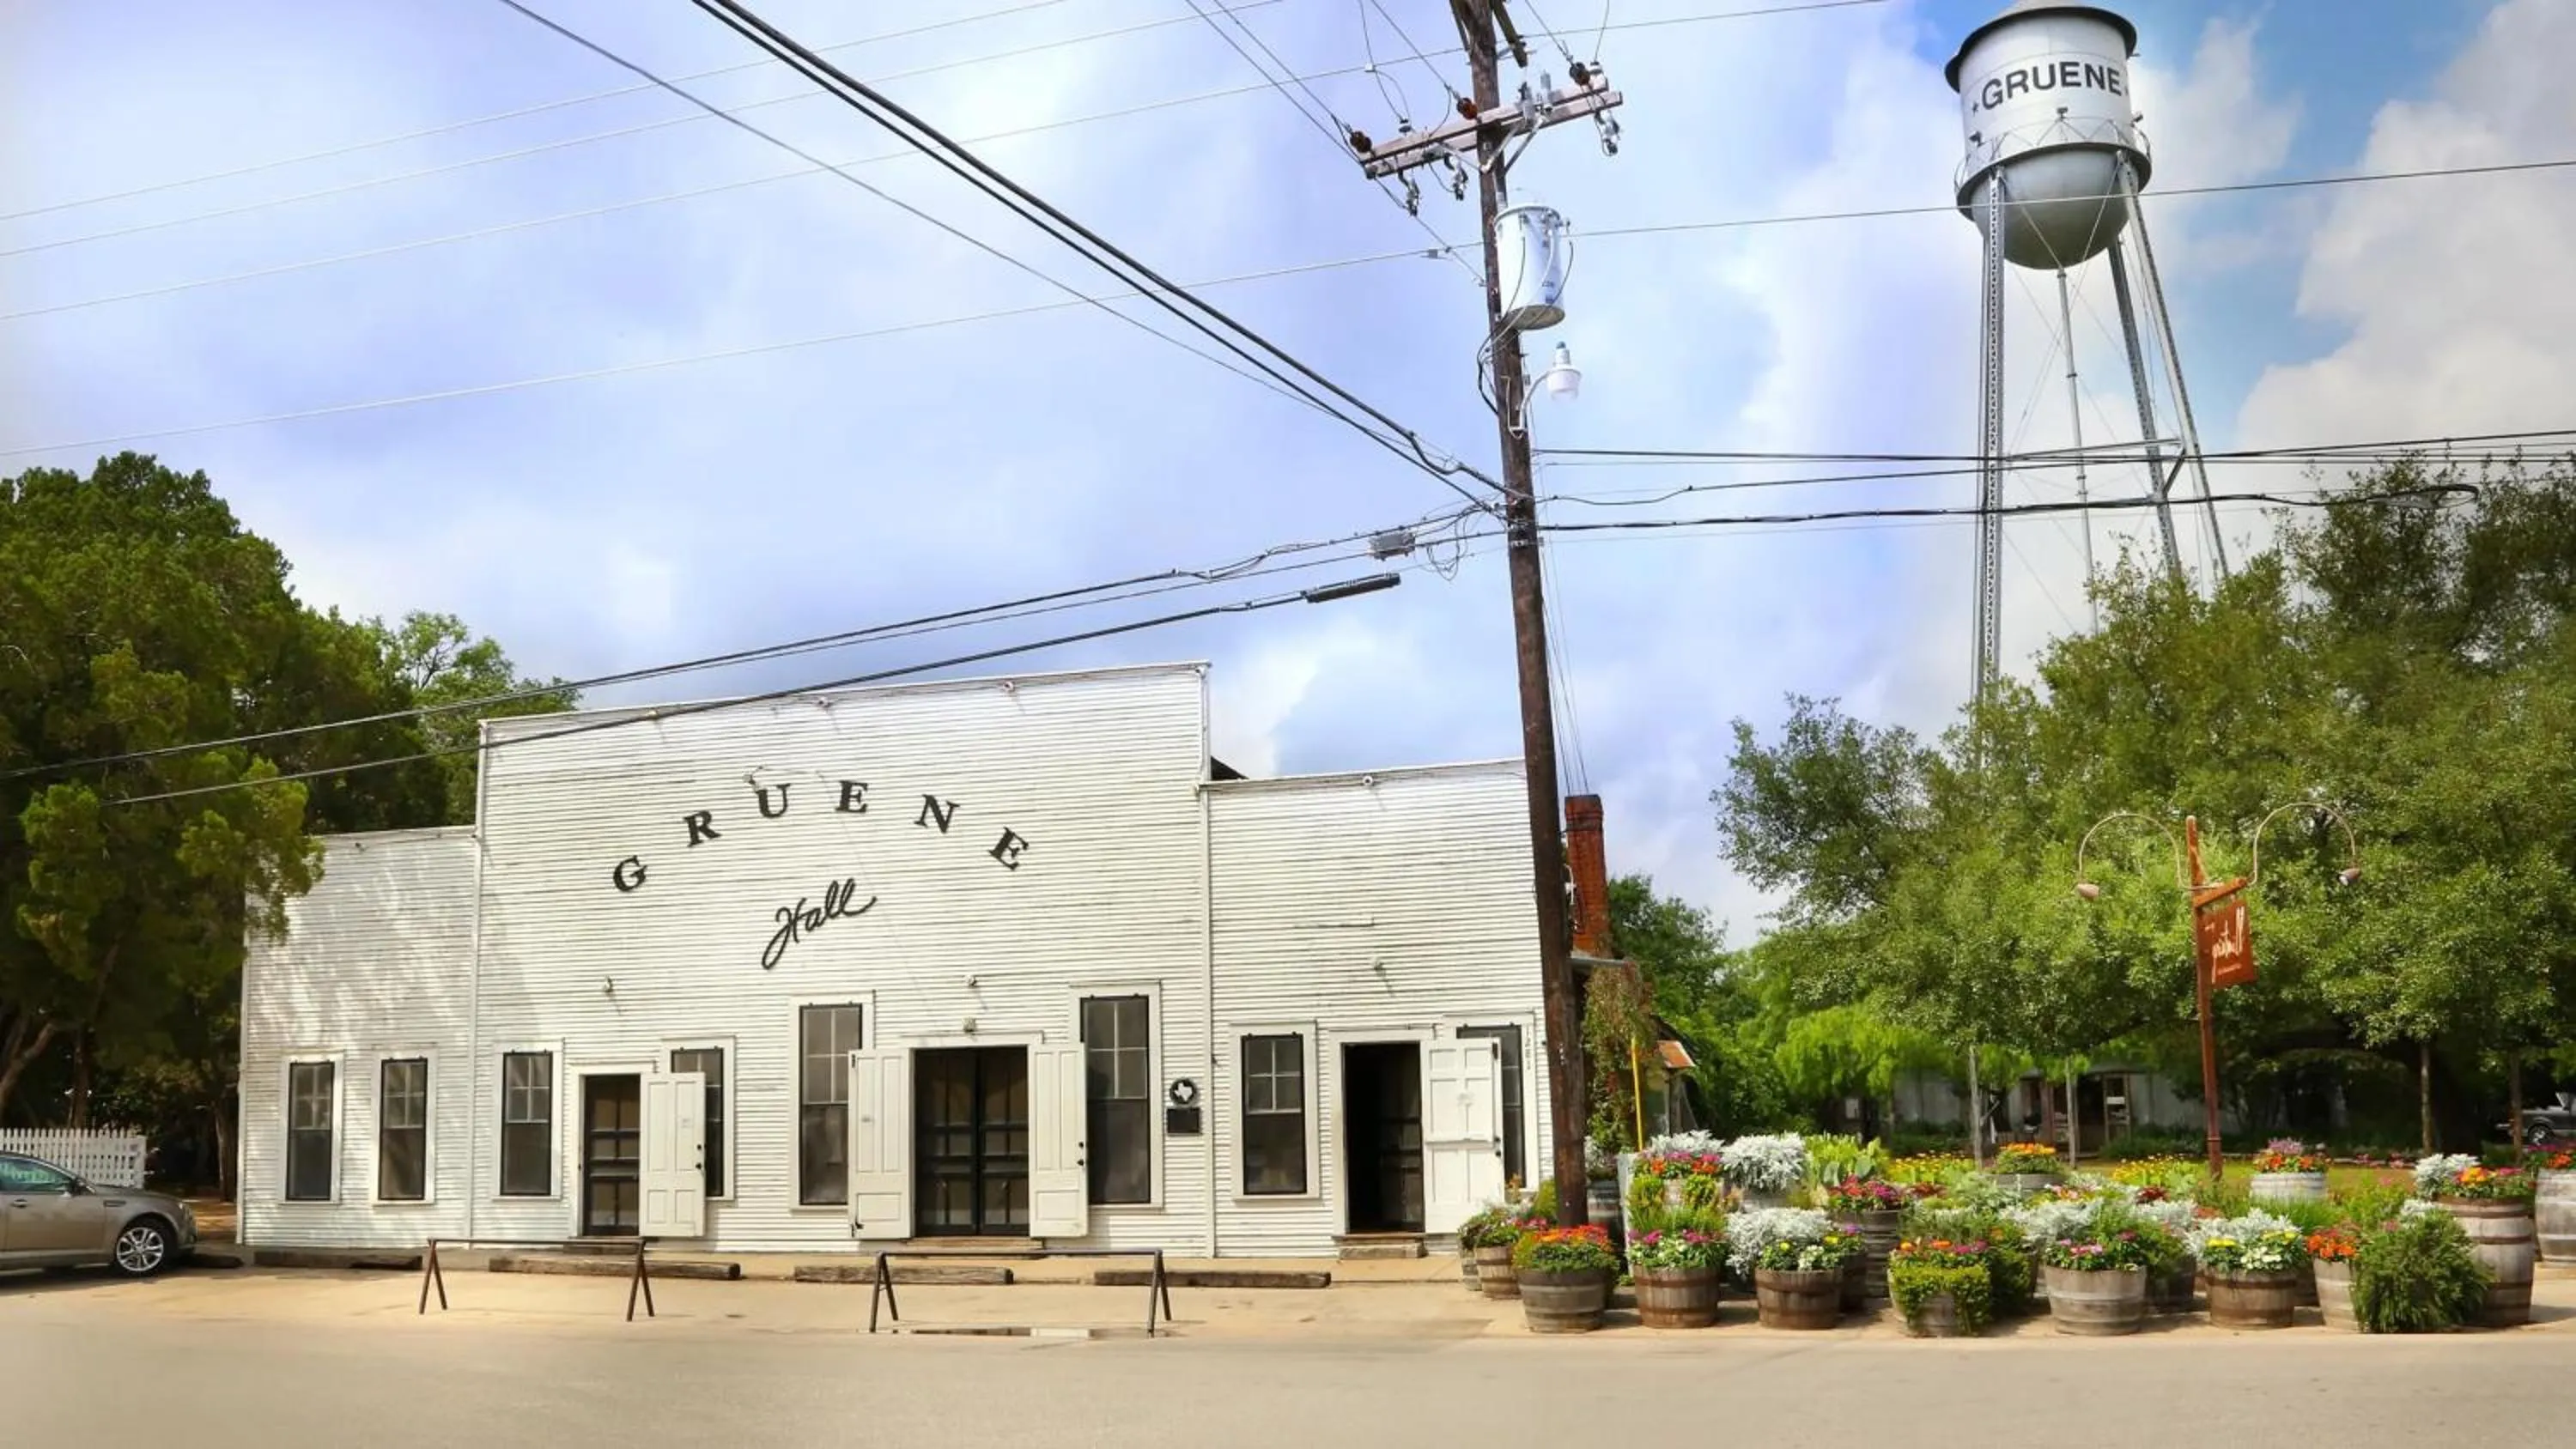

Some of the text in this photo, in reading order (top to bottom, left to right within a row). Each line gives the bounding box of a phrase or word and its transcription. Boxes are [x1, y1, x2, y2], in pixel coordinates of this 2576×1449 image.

[1981, 61, 2122, 110] GRUENE
[612, 779, 1029, 894] GRUENE
[762, 878, 878, 970] Hall
